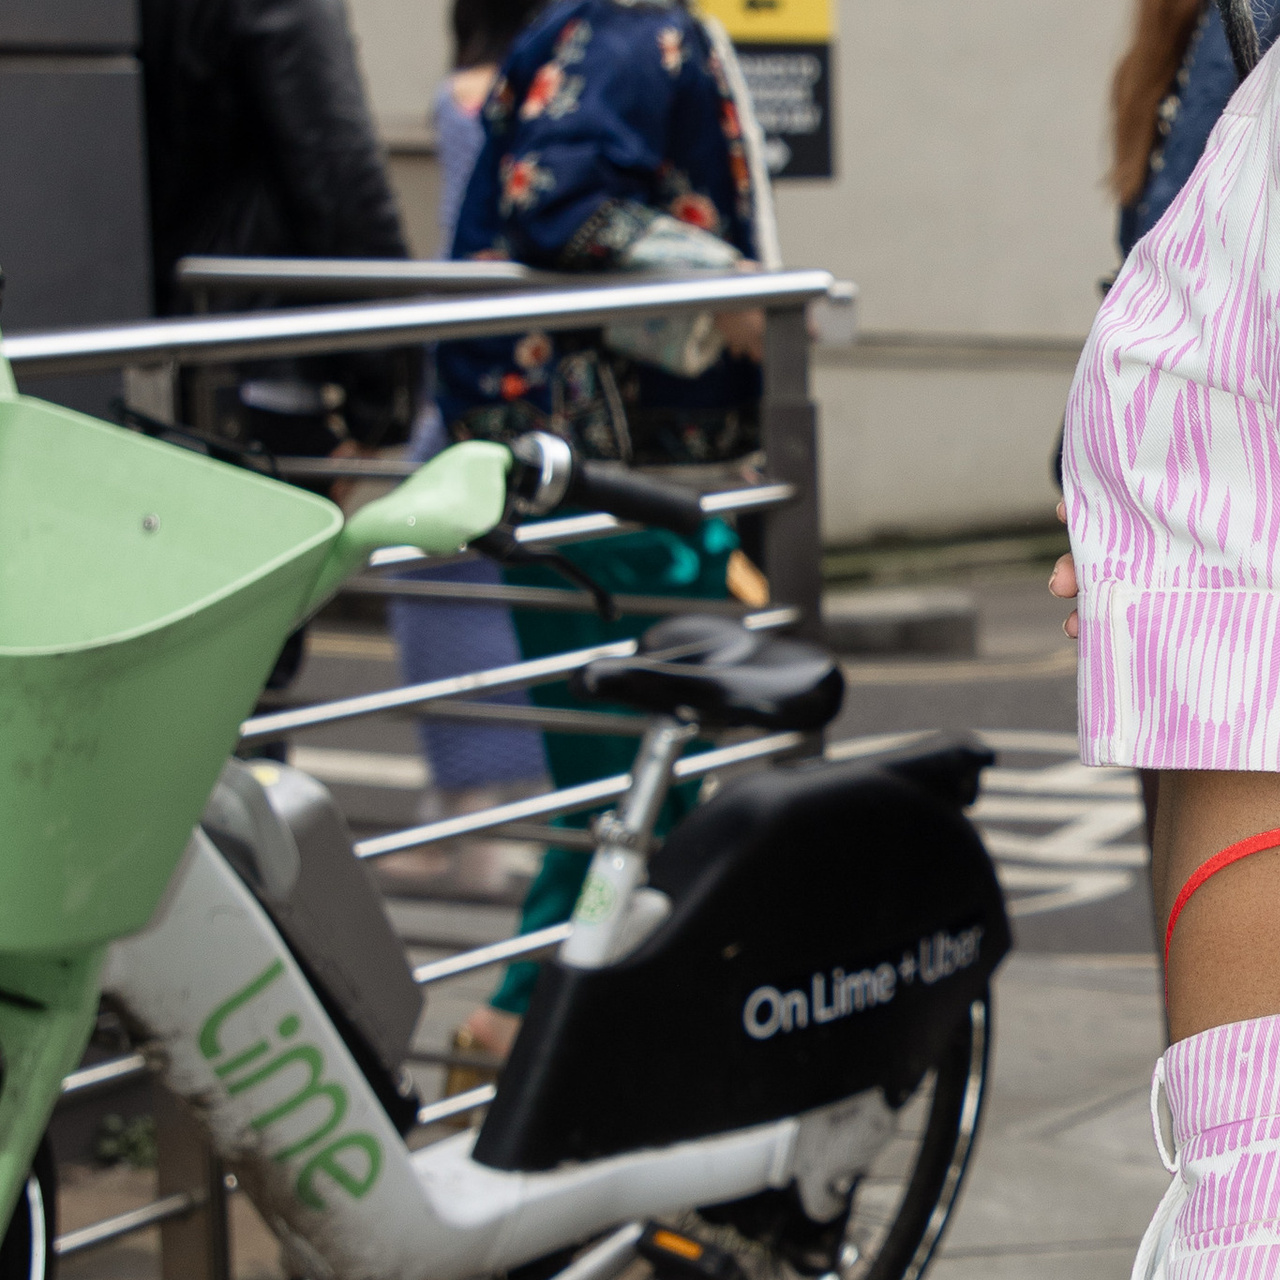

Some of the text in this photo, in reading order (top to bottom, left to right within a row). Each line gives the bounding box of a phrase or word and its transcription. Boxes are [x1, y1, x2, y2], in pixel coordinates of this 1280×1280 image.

[743, 985, 809, 1040] On
[812, 963, 897, 1023] Lime
[918, 925, 984, 984] Uber
[197, 957, 384, 1211] Lime
